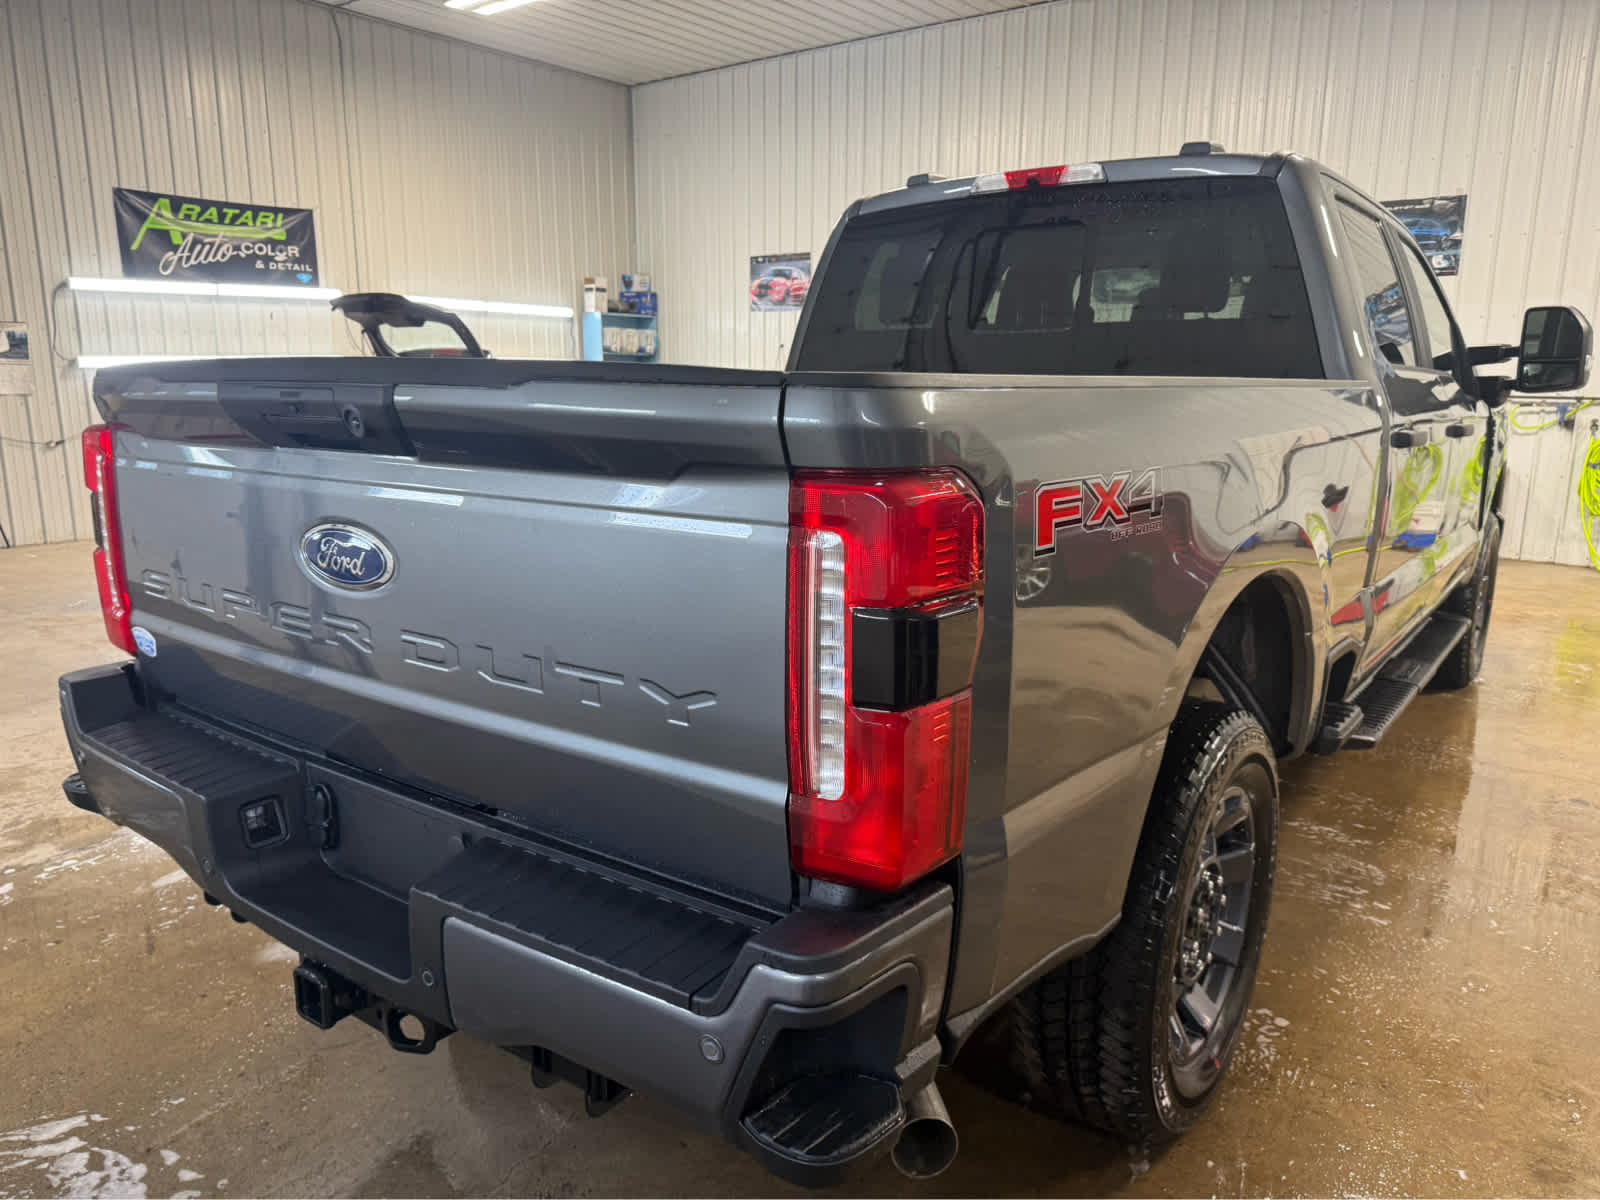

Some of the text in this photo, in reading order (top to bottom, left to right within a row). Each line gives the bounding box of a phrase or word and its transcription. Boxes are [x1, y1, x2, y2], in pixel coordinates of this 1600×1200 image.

[130, 198, 285, 250] ARATARI
[159, 232, 234, 275] Auto
[255, 260, 312, 272] & DETAIL
[1033, 465, 1165, 559] FX4
[317, 536, 366, 577] Ford
[141, 568, 717, 727] SUPER DUTY
